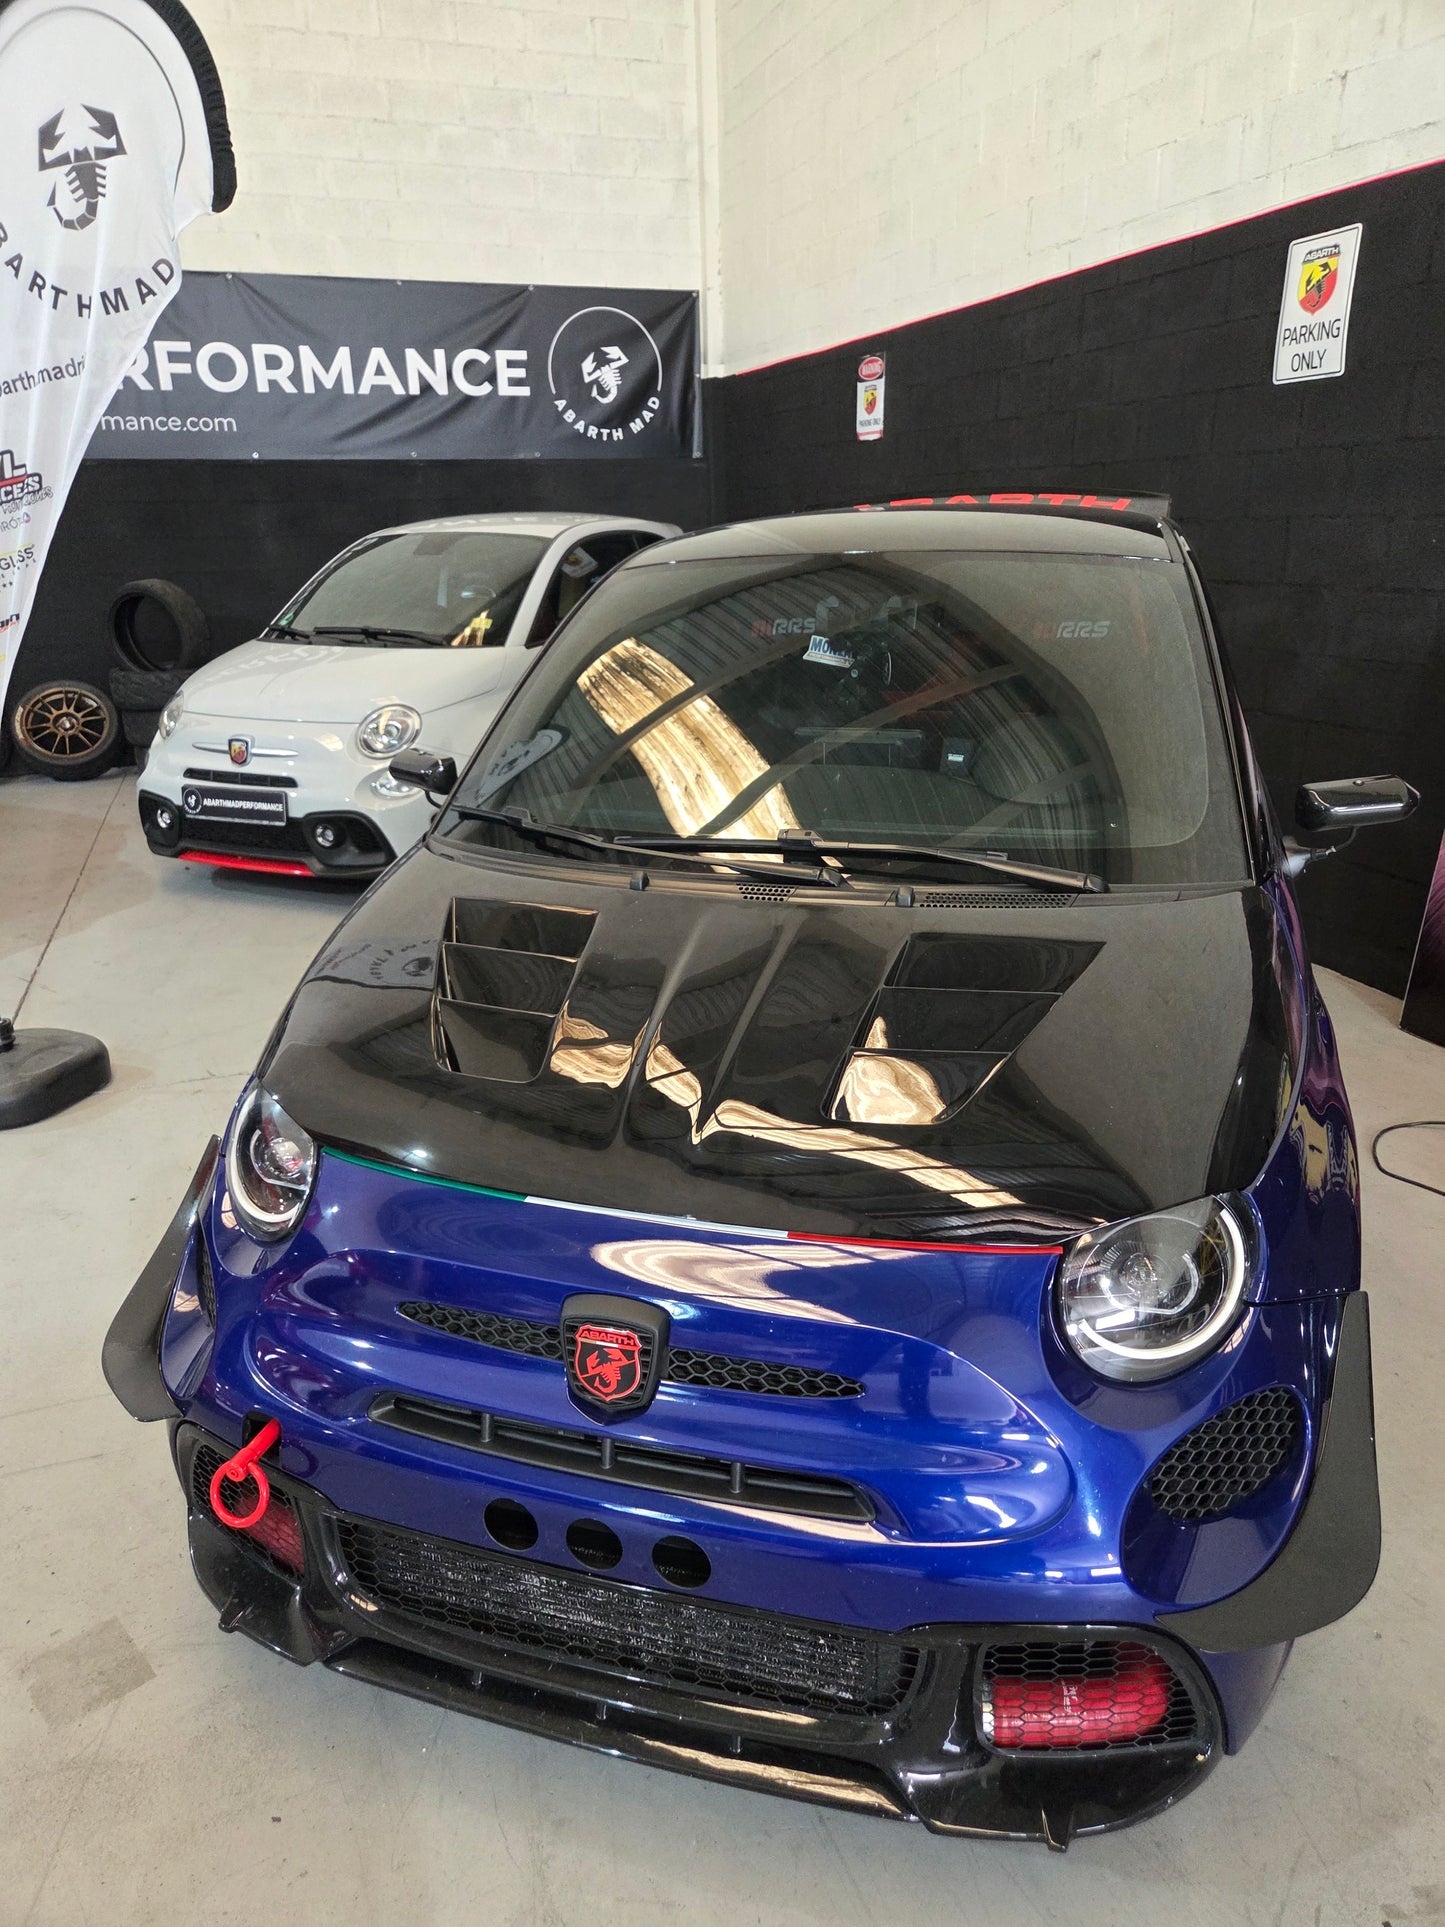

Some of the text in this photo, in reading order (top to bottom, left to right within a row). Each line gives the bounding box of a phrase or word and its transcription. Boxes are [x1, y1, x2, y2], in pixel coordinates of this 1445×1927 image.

[1304, 247, 1339, 261] ABARTH
[1282, 318, 1341, 347] PARKING
[1291, 349, 1327, 372] ONLY
[101, 414, 237, 432] mance.com
[554, 397, 660, 441] ABARTH MAD
[581, 1331, 634, 1346] ABARTH
